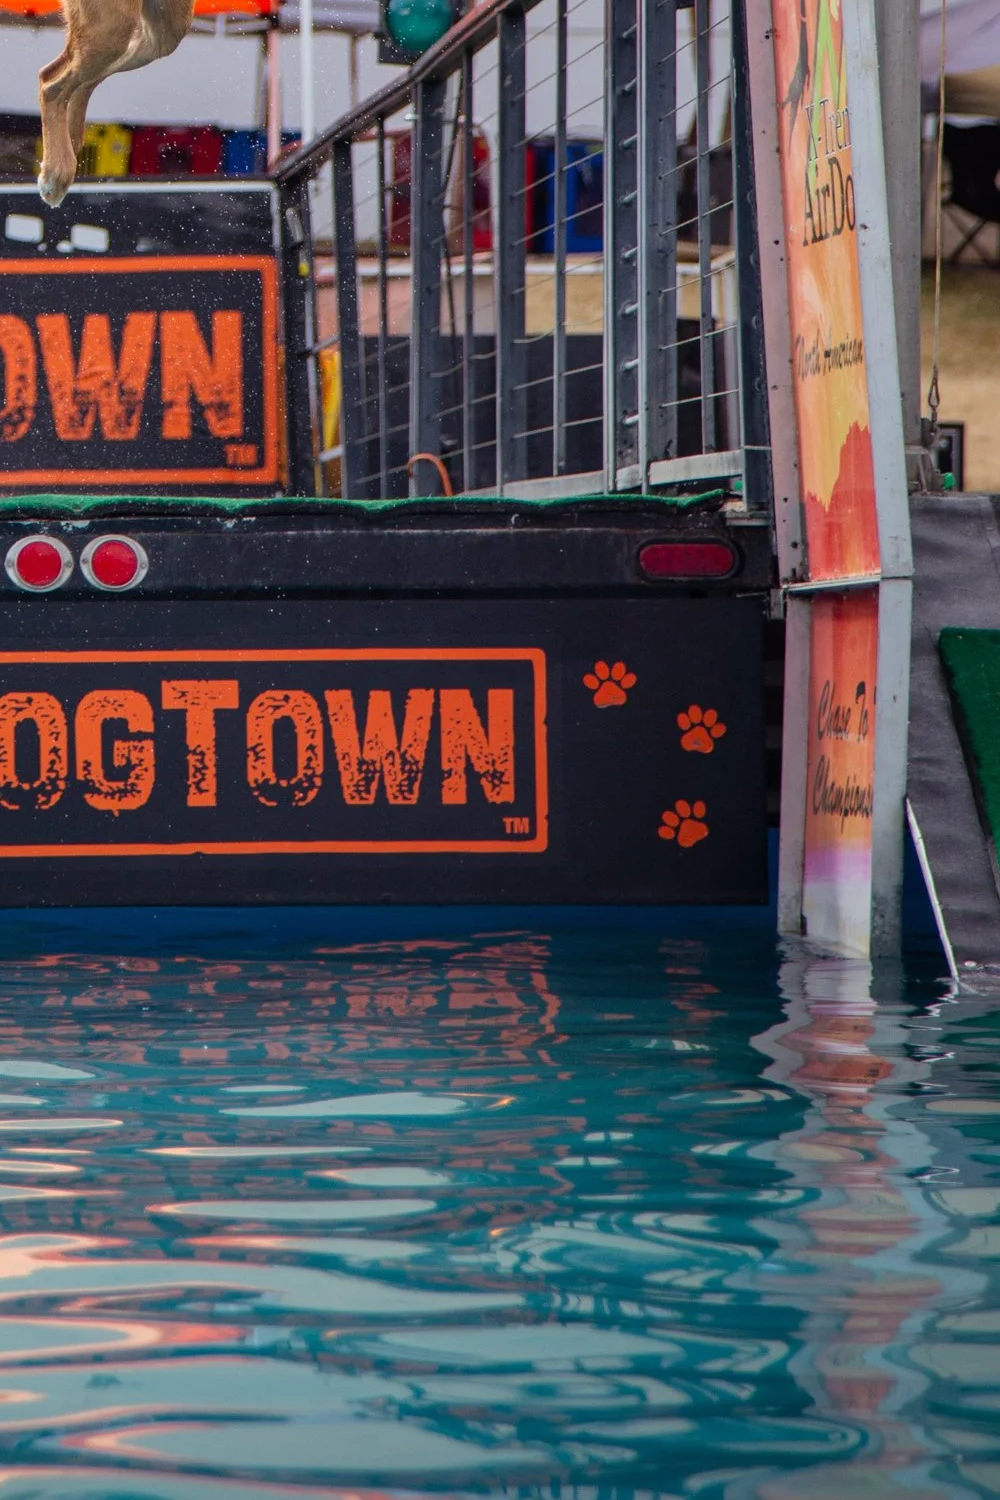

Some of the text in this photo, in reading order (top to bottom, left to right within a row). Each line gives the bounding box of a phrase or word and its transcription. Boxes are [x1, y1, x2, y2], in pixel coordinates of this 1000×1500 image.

[796, 327, 863, 381] North American
[817, 679, 869, 743] Chase To
[502, 817, 530, 834] TM
